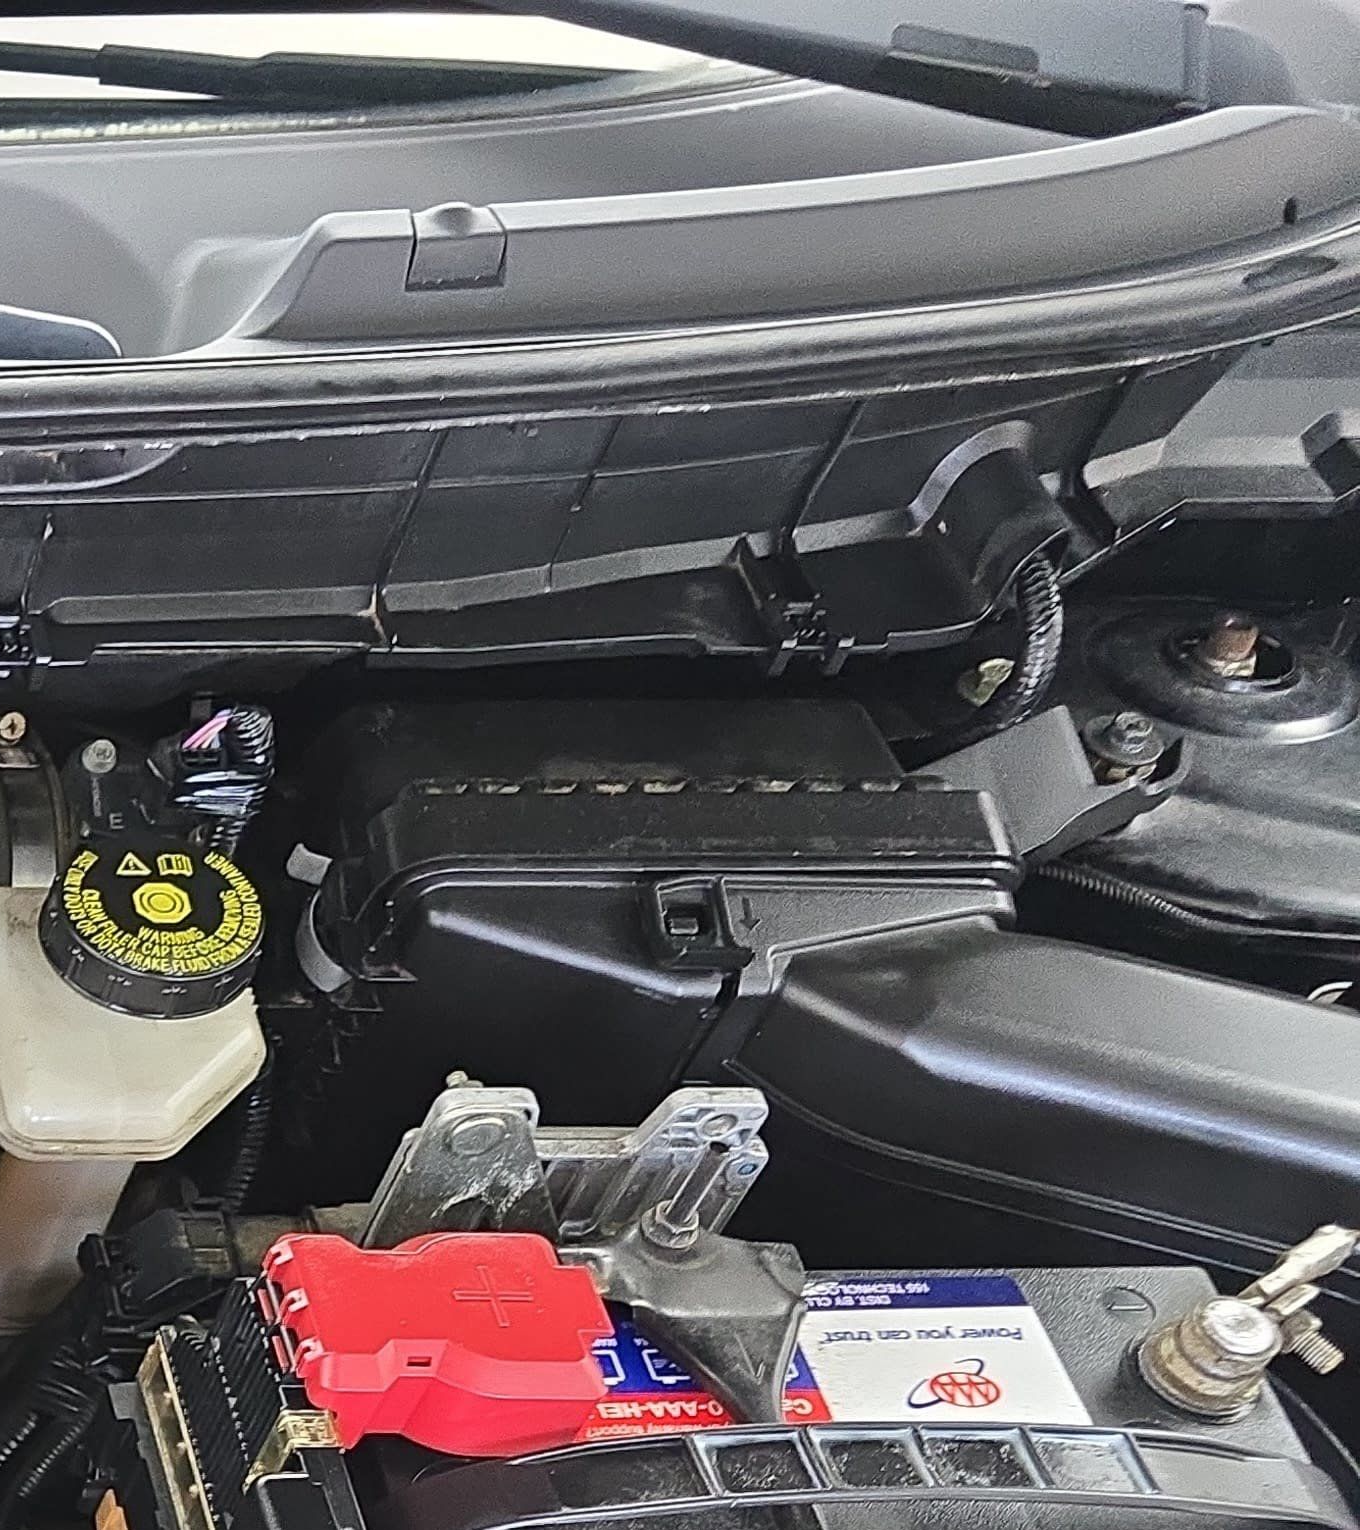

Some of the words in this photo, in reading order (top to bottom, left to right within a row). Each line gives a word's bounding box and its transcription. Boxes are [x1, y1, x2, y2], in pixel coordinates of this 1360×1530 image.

[125, 950, 170, 973] BRAKE
[204, 851, 259, 902] CONTAINER
[82, 889, 108, 922] CLEAN
[98, 919, 140, 949] FILLER
[142, 943, 169, 958] CAP
[172, 935, 226, 959] BEFORE
[137, 926, 205, 945] WARNING
[877, 1330, 910, 1341] can
[916, 1325, 954, 1341] you
[961, 1328, 1023, 1341] Power
[934, 1376, 996, 1407] AAA
